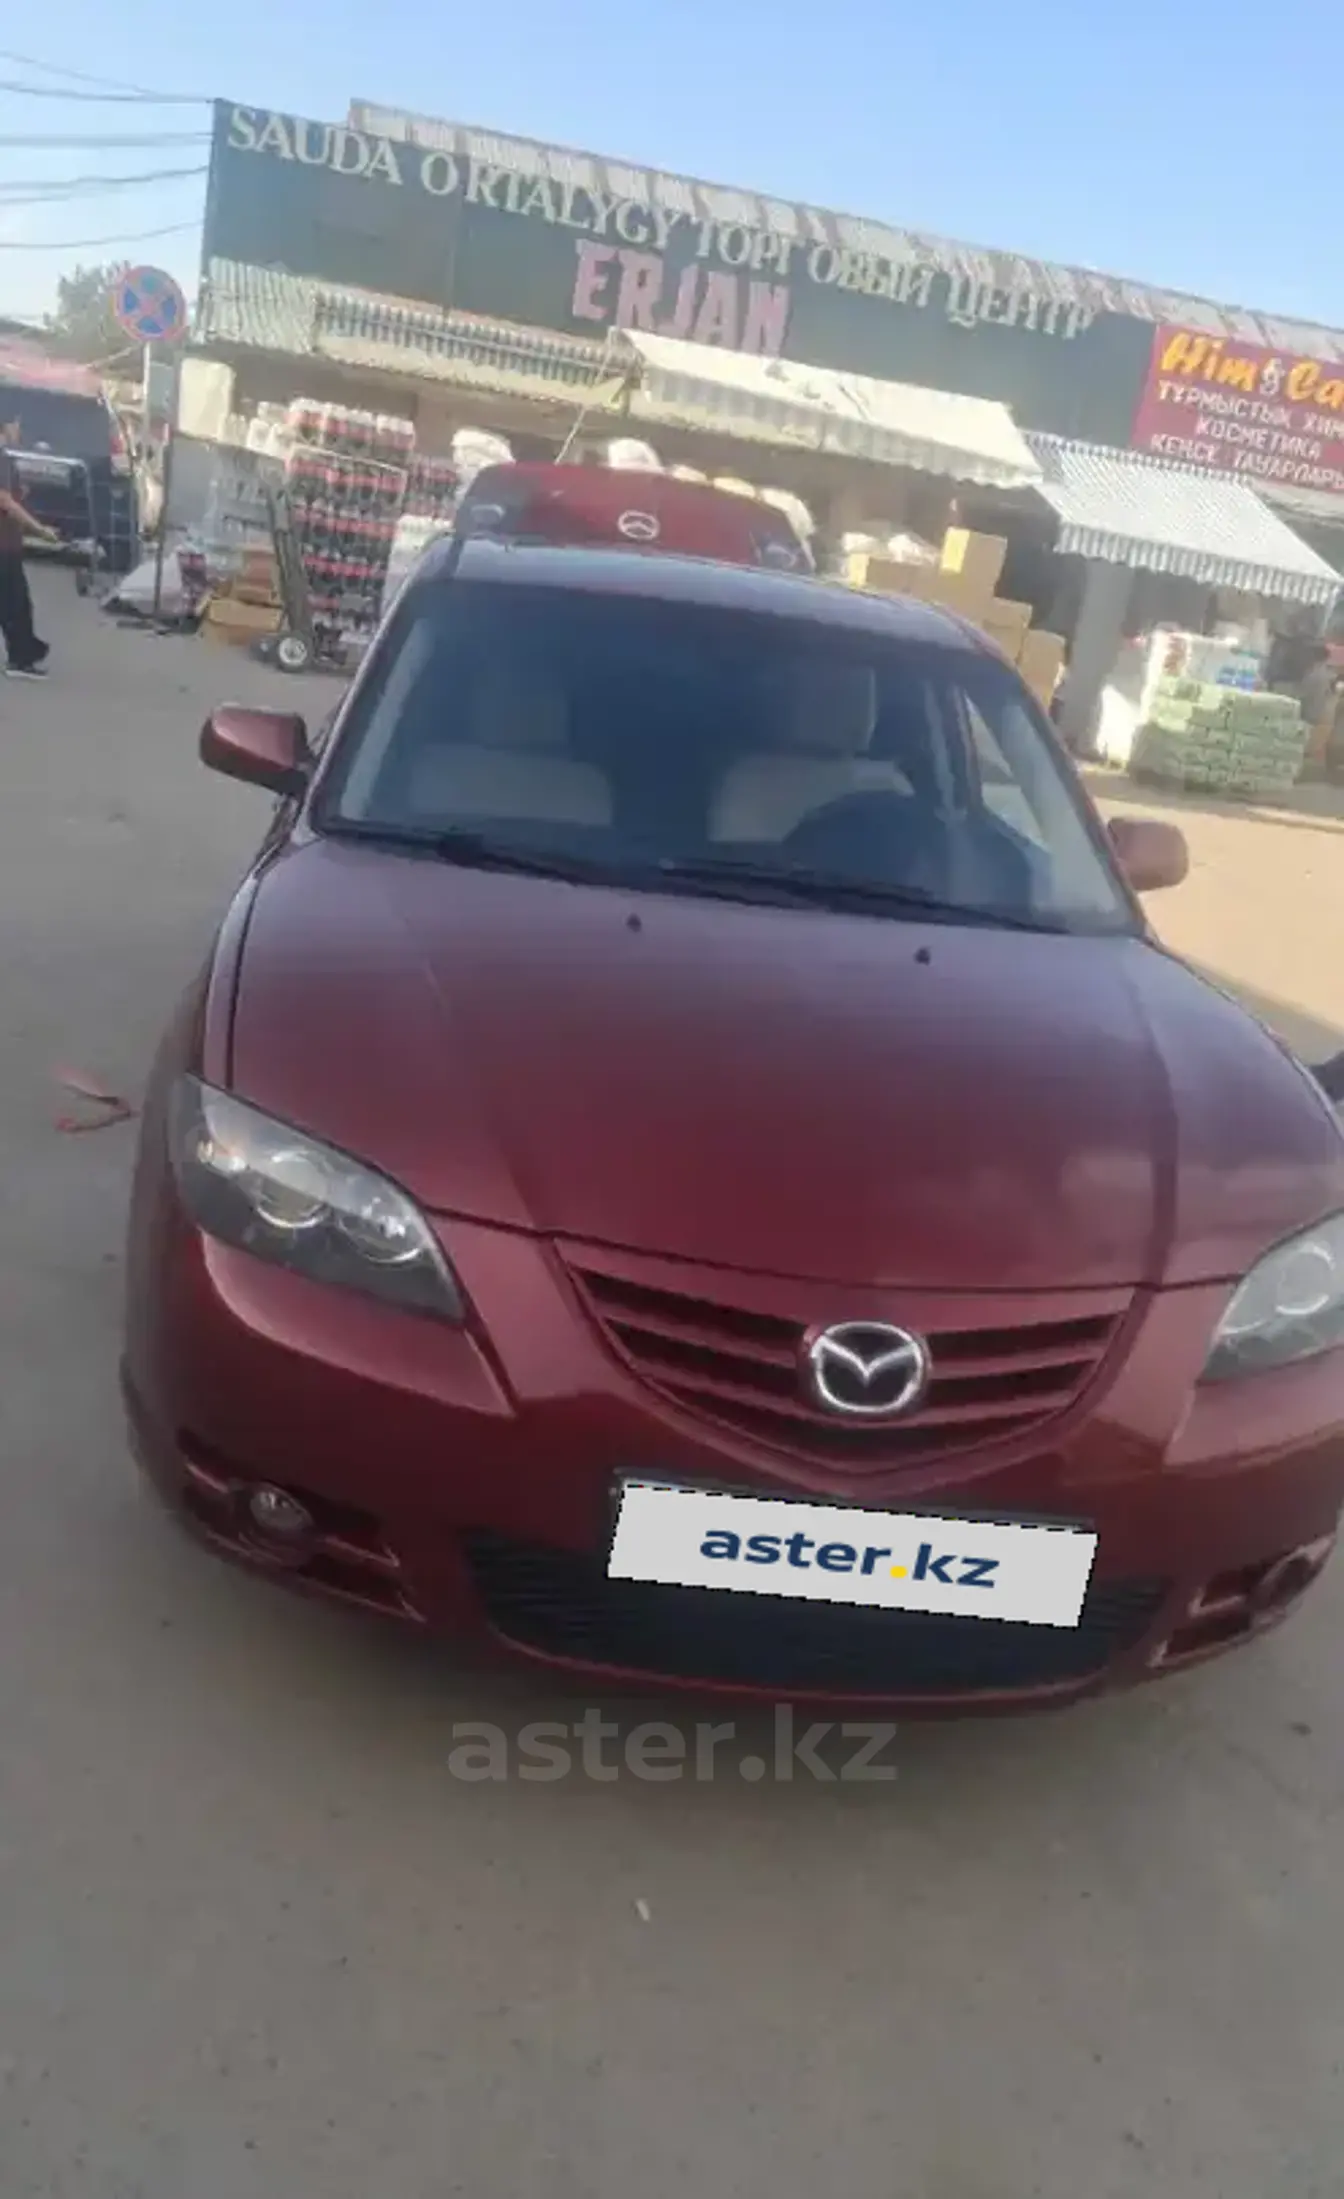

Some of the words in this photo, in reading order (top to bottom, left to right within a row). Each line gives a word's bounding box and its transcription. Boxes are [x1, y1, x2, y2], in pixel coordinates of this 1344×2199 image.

[228, 107, 403, 186] SAUDA
[946, 270, 1096, 339] ЦЕНТР
[572, 238, 790, 358] ERJAN
[1195, 412, 1322, 462] КОСМЕТИКА
